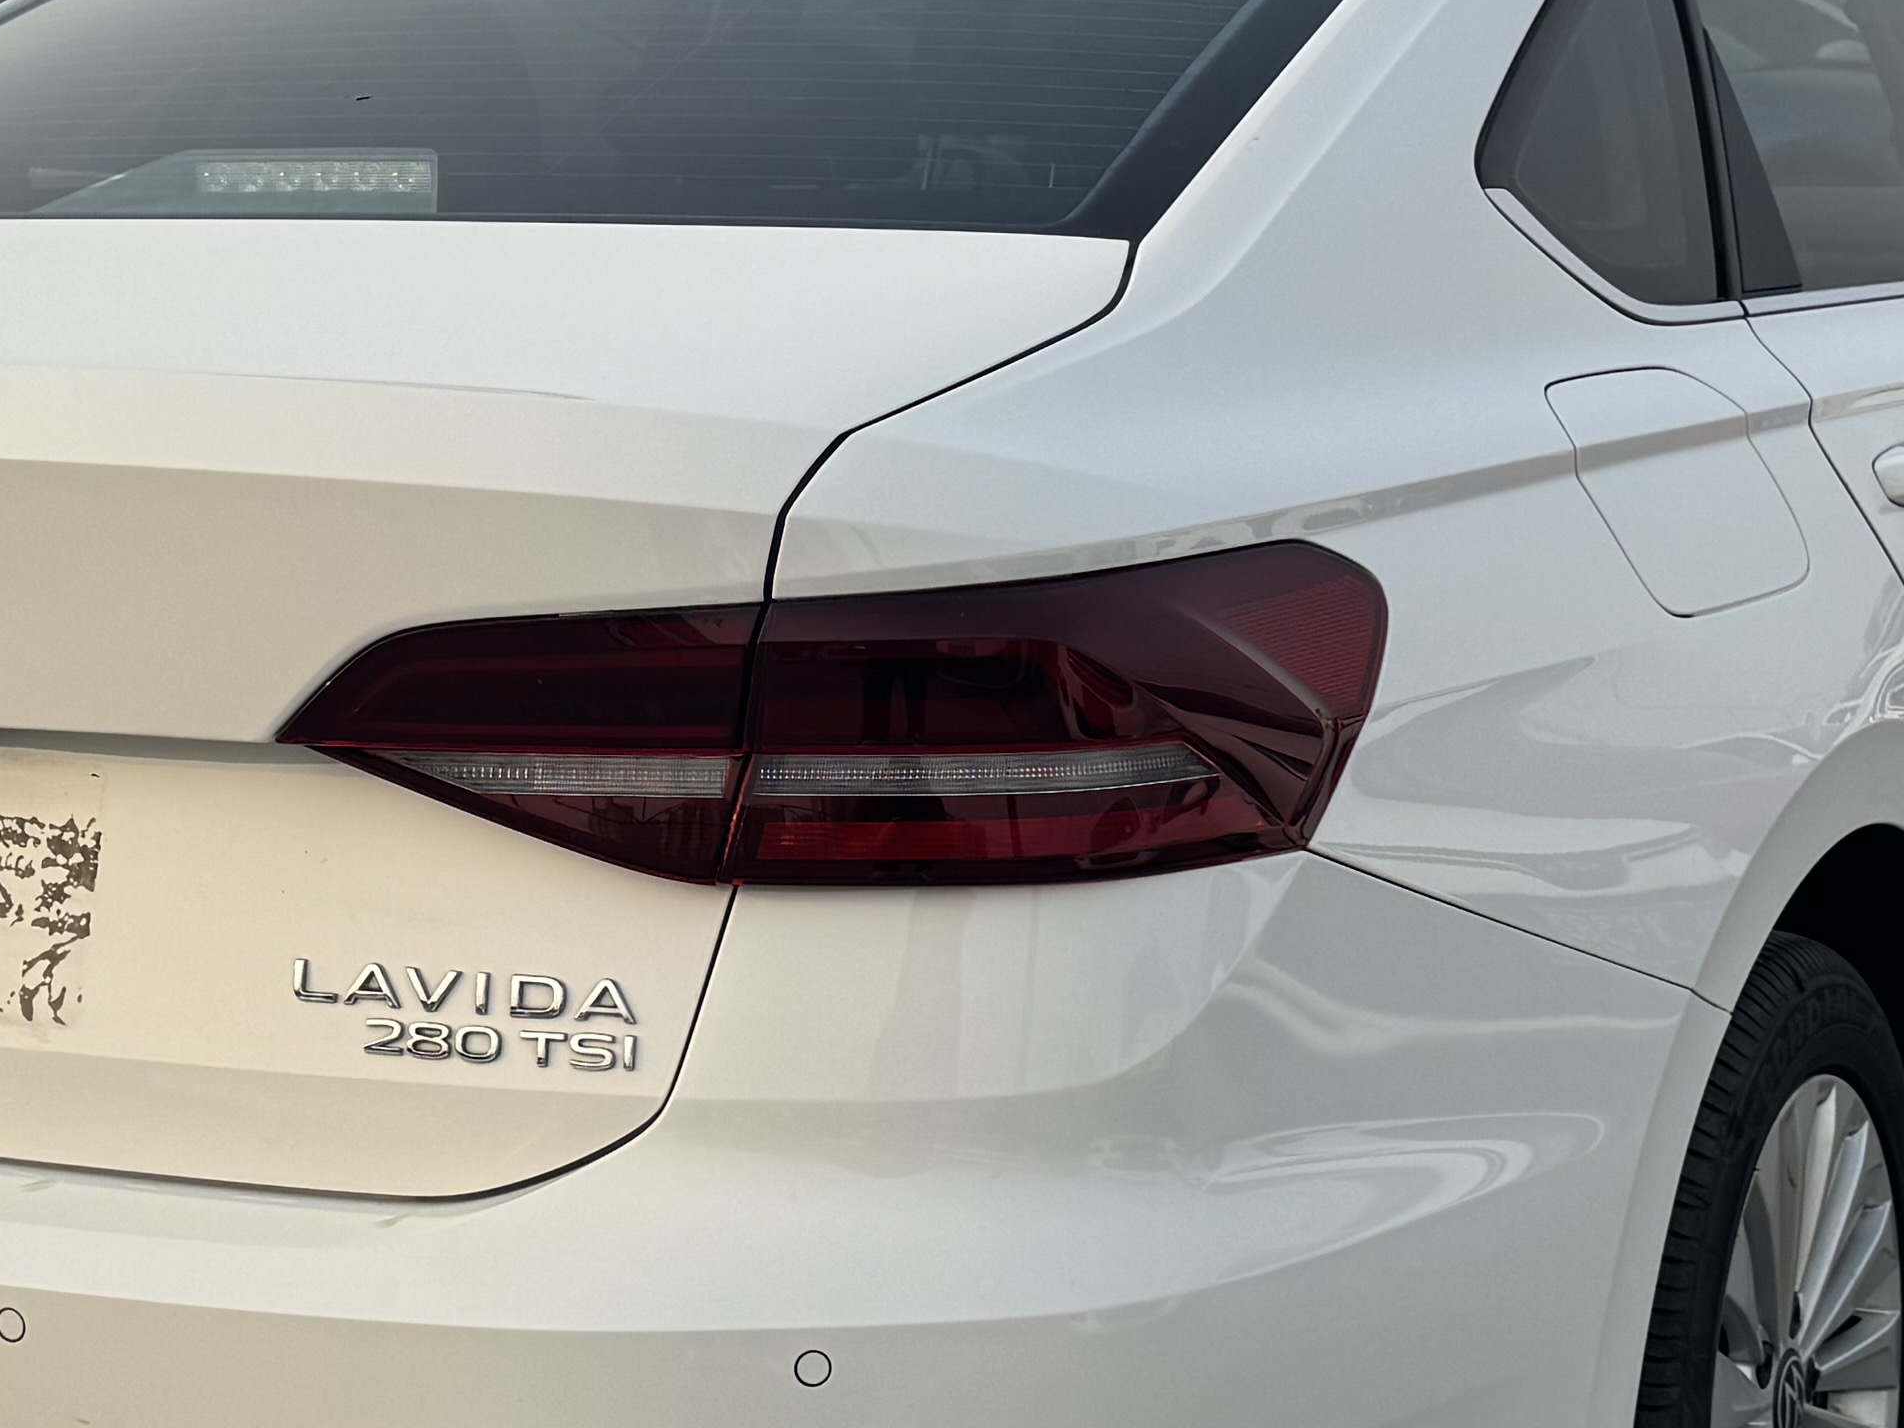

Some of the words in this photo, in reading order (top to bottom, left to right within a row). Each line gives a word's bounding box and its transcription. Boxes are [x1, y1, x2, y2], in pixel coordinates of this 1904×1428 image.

[292, 958, 638, 1026] LAVIDA
[362, 1017, 503, 1064] 280
[519, 1028, 638, 1072] TSI
